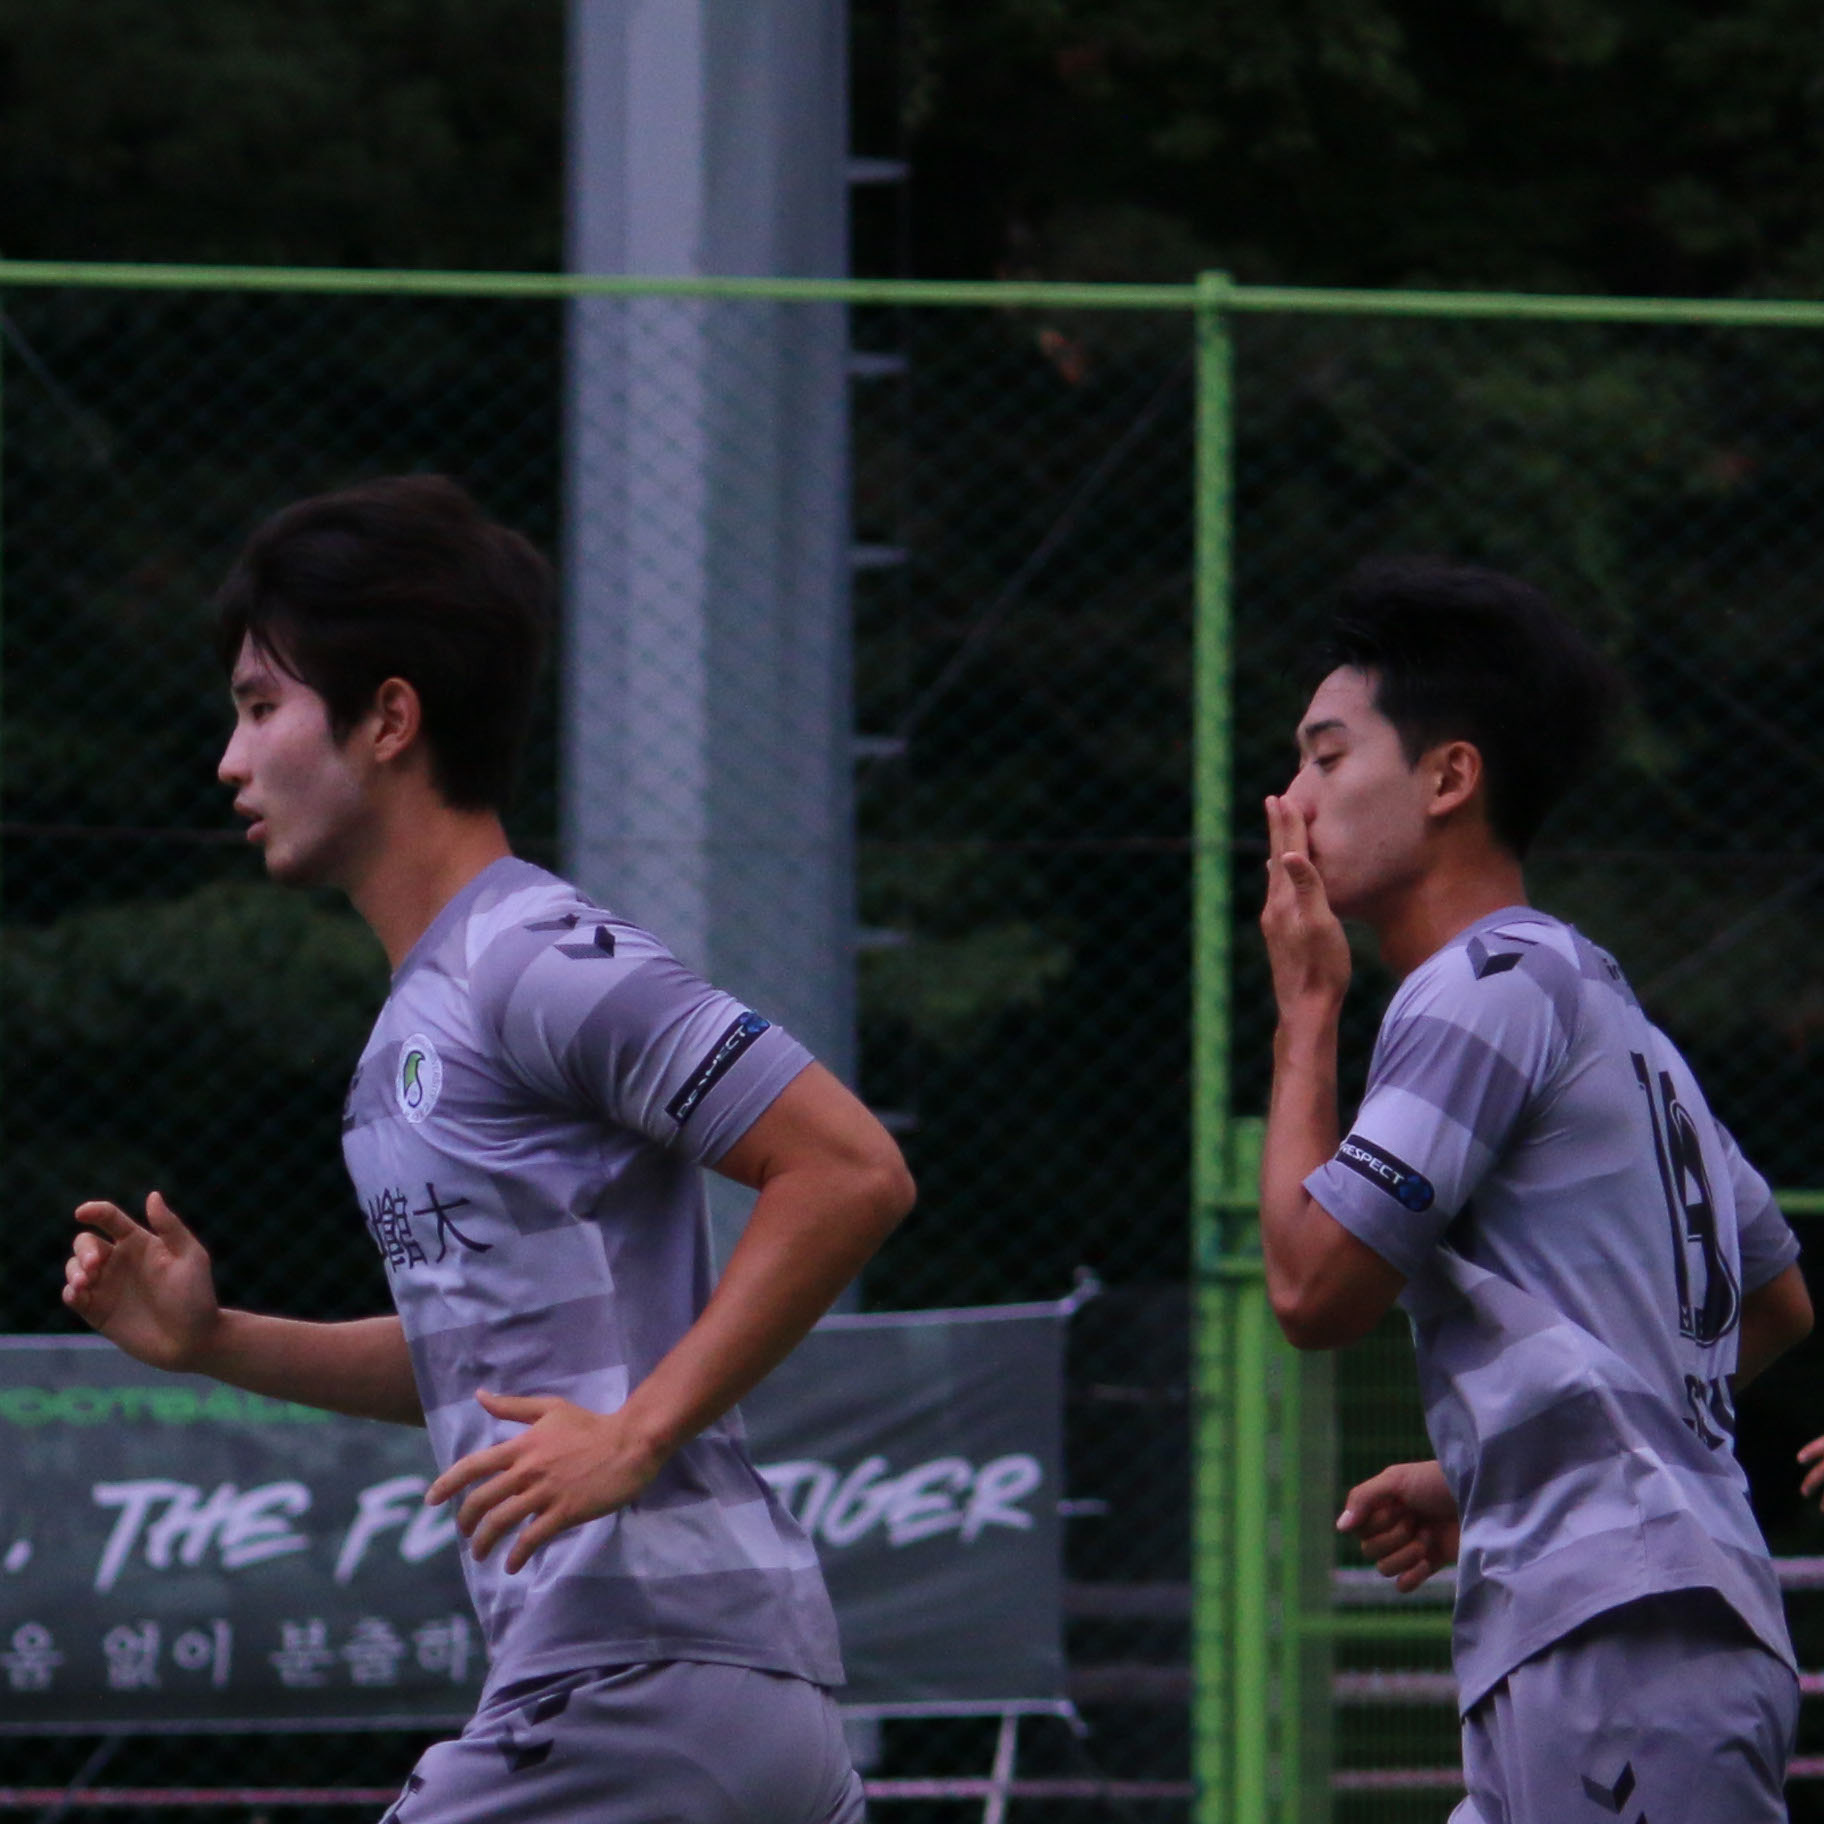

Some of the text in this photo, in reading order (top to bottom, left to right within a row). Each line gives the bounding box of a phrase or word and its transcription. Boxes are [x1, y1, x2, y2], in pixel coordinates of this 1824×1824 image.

[92, 1479, 317, 1592] THE
[101, 1617, 234, 1691] 없이
[268, 1612, 475, 1690] 분출하
